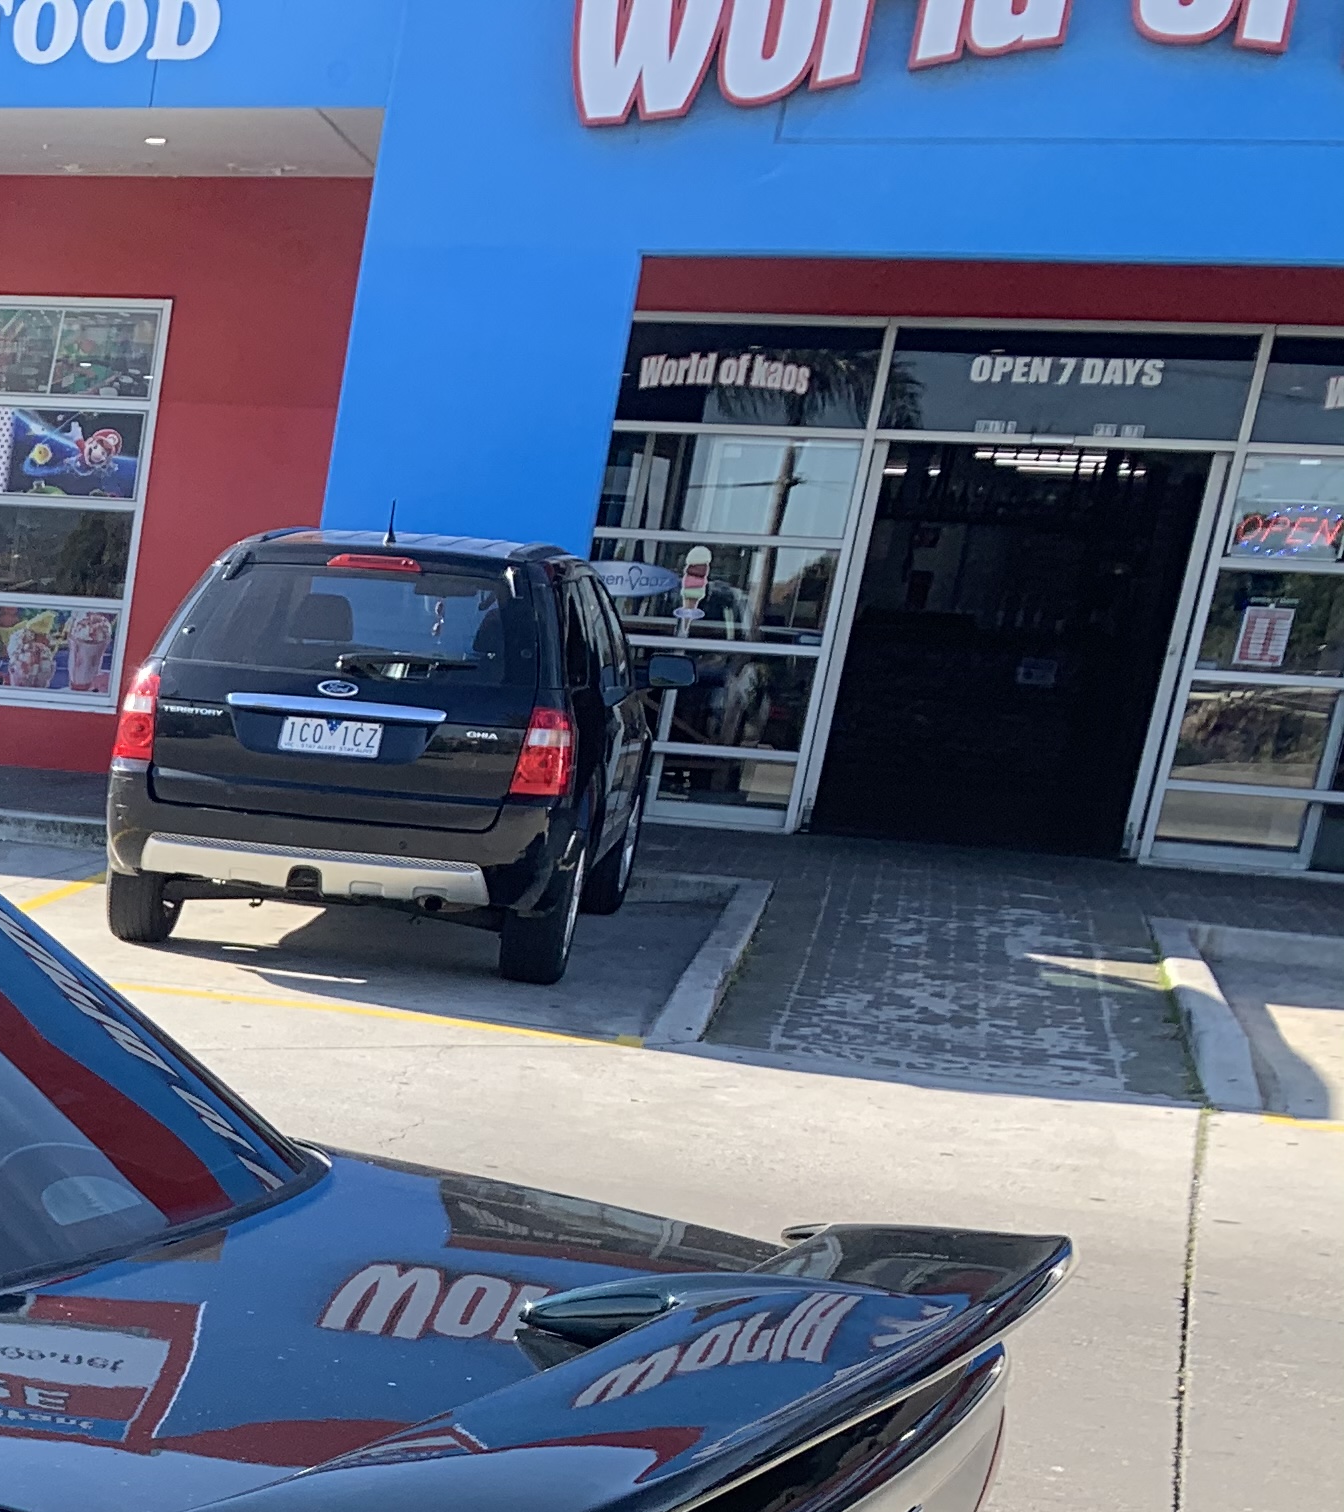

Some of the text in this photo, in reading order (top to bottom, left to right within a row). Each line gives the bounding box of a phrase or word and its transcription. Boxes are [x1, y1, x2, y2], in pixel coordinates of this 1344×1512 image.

[639, 352, 811, 395] World of kaos
[969, 355, 1165, 387] OPEN 7 DAYS
[1235, 513, 1343, 546] OPEN
[162, 704, 224, 718] TERRITORY
[465, 730, 499, 741] GHIA
